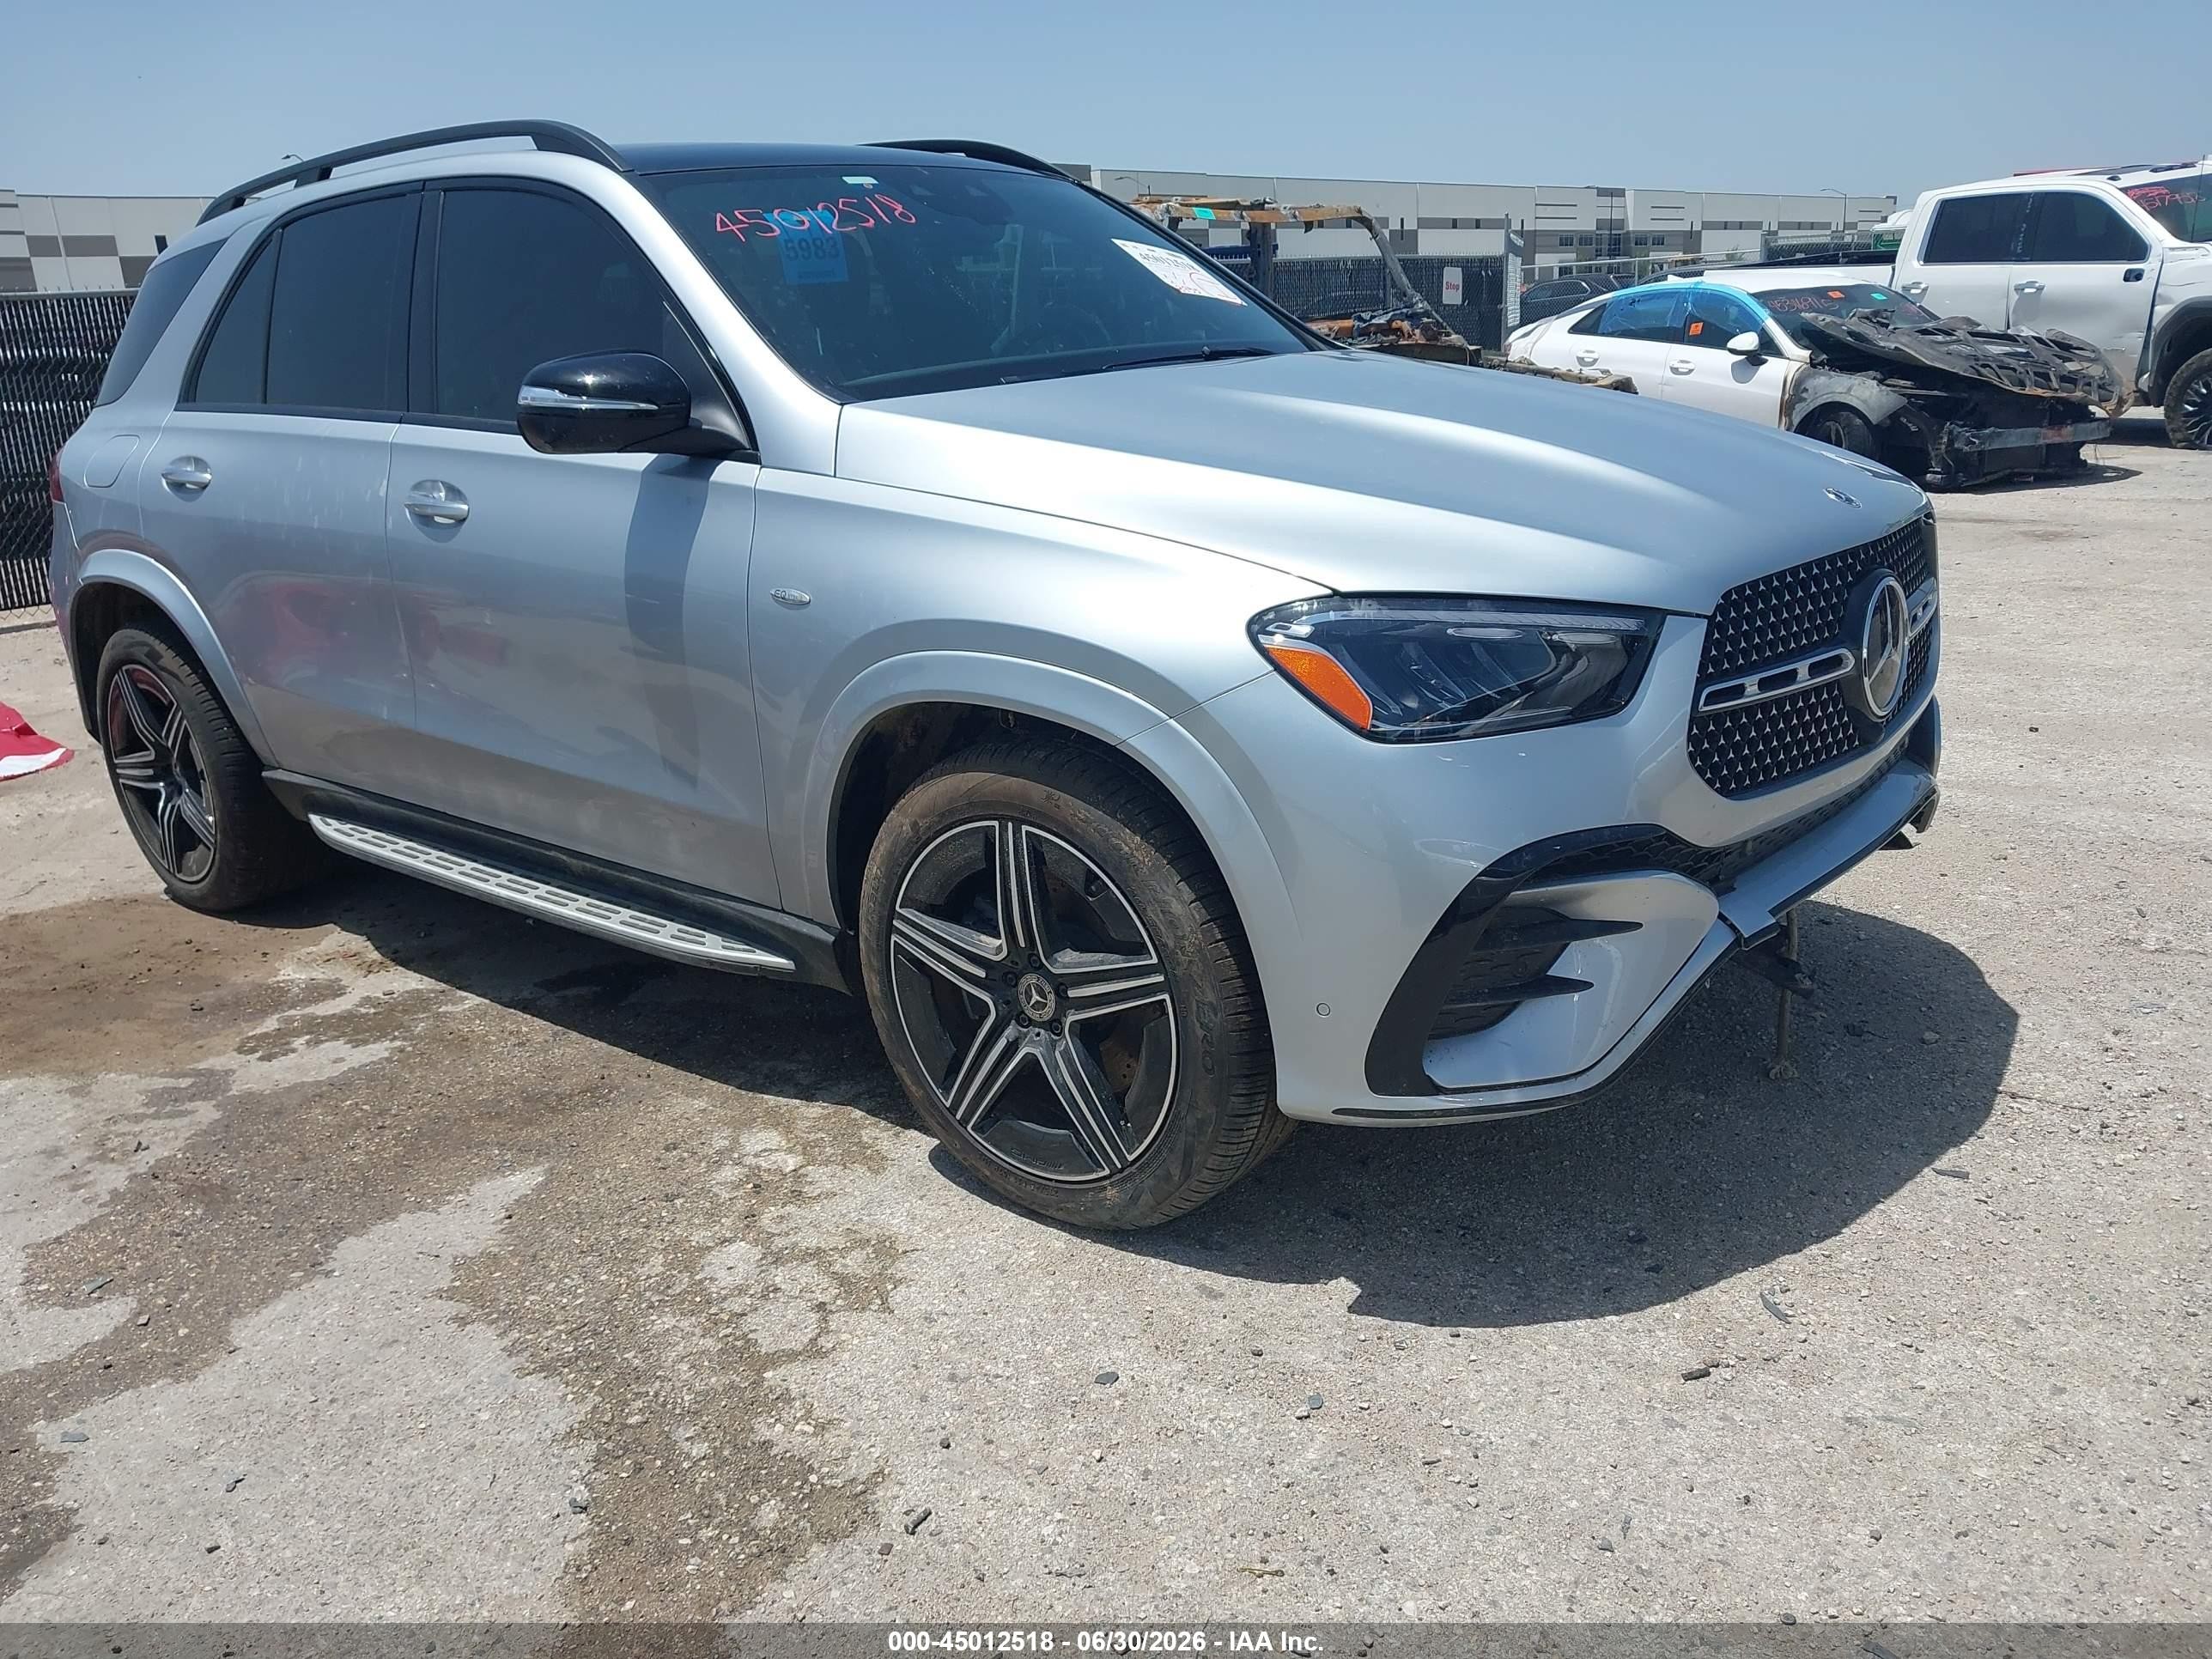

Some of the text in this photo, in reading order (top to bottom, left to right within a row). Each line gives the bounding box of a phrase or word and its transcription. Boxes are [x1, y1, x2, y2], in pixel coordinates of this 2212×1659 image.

[716, 194, 916, 242] 45012518
[784, 236, 839, 262] 5983
[1445, 281, 1460, 292] Stop
[774, 589, 787, 599] EQ
